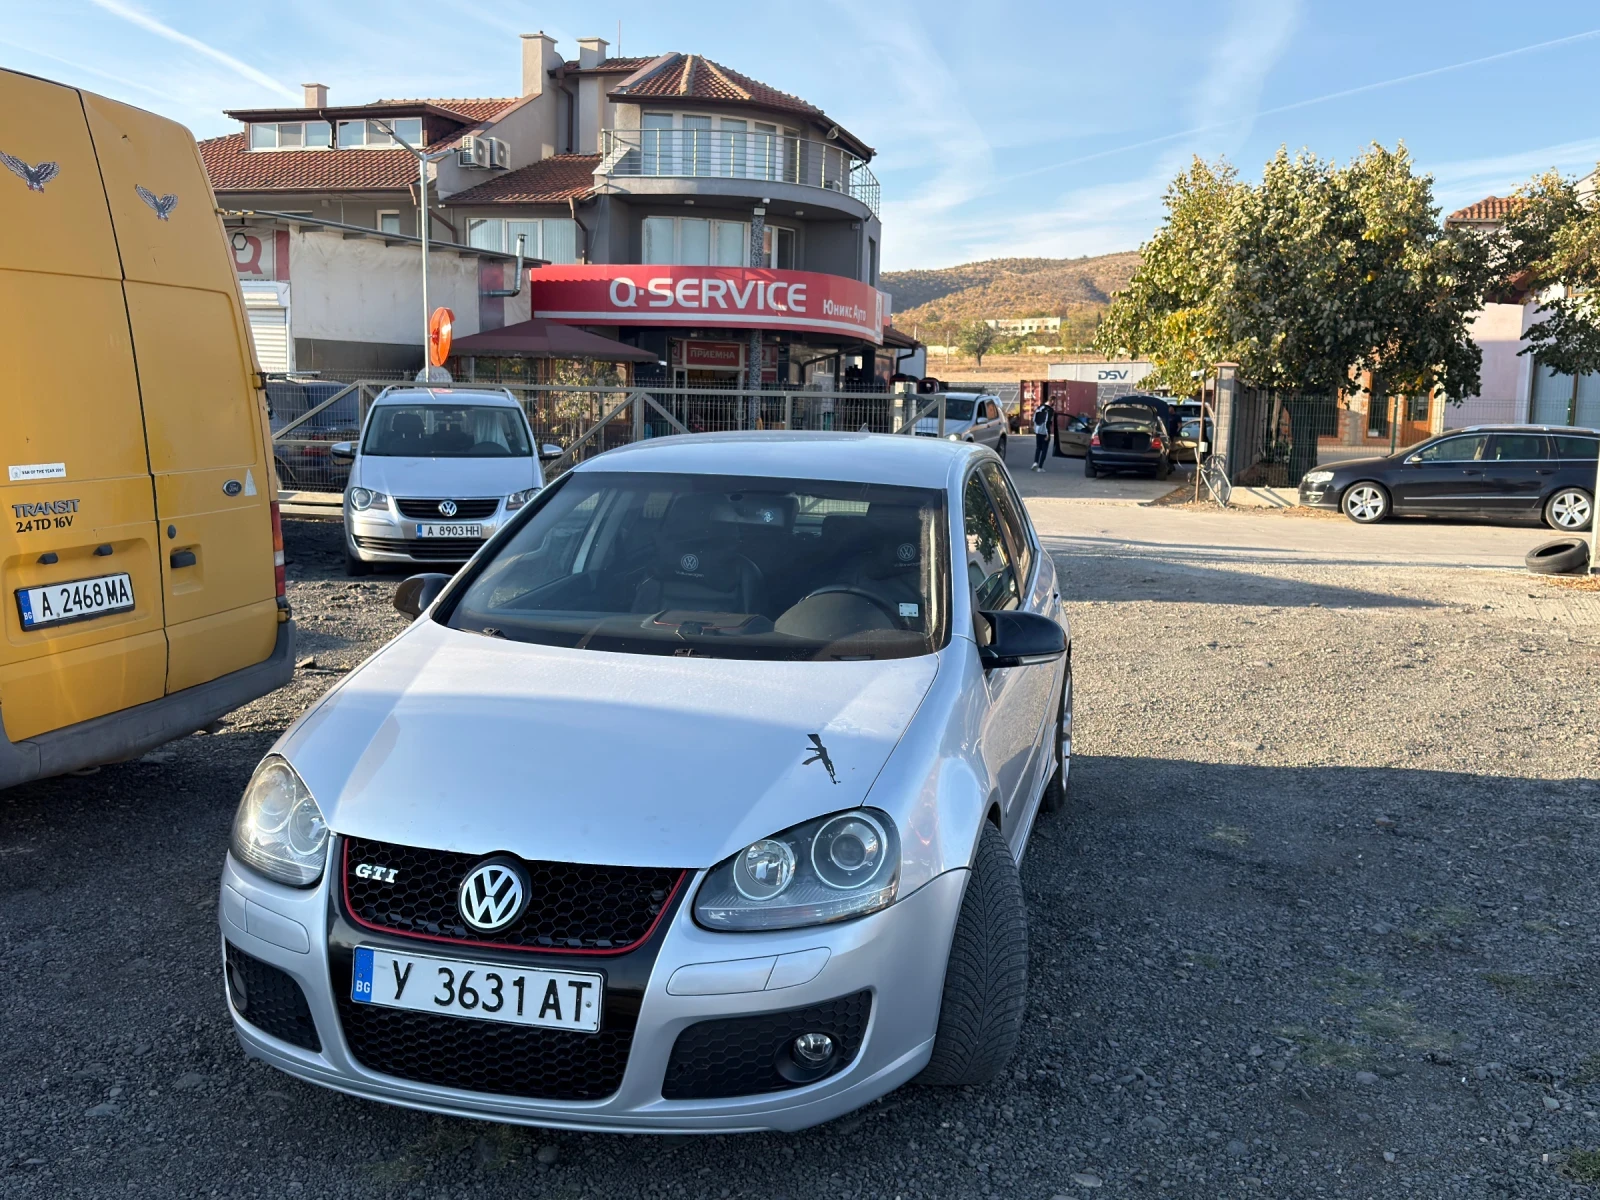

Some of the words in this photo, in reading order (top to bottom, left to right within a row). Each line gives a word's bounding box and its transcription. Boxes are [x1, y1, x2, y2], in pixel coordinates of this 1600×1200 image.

[690, 349, 735, 360] ПРИЕМНА
[1098, 370, 1128, 380] DSV
[12, 499, 80, 518] TRANSIT
[34, 518, 51, 530] TD
[53, 515, 74, 528] 16V
[427, 526, 434, 536] A
[439, 526, 464, 536] 8903
[42, 591, 53, 618] A
[60, 583, 104, 613] 2468
[105, 578, 130, 605] MA
[23, 611, 33, 621] BG
[355, 863, 399, 883] GTI
[356, 980, 371, 994] BG
[433, 967, 527, 1016] 3631
[538, 978, 592, 1022] AT
